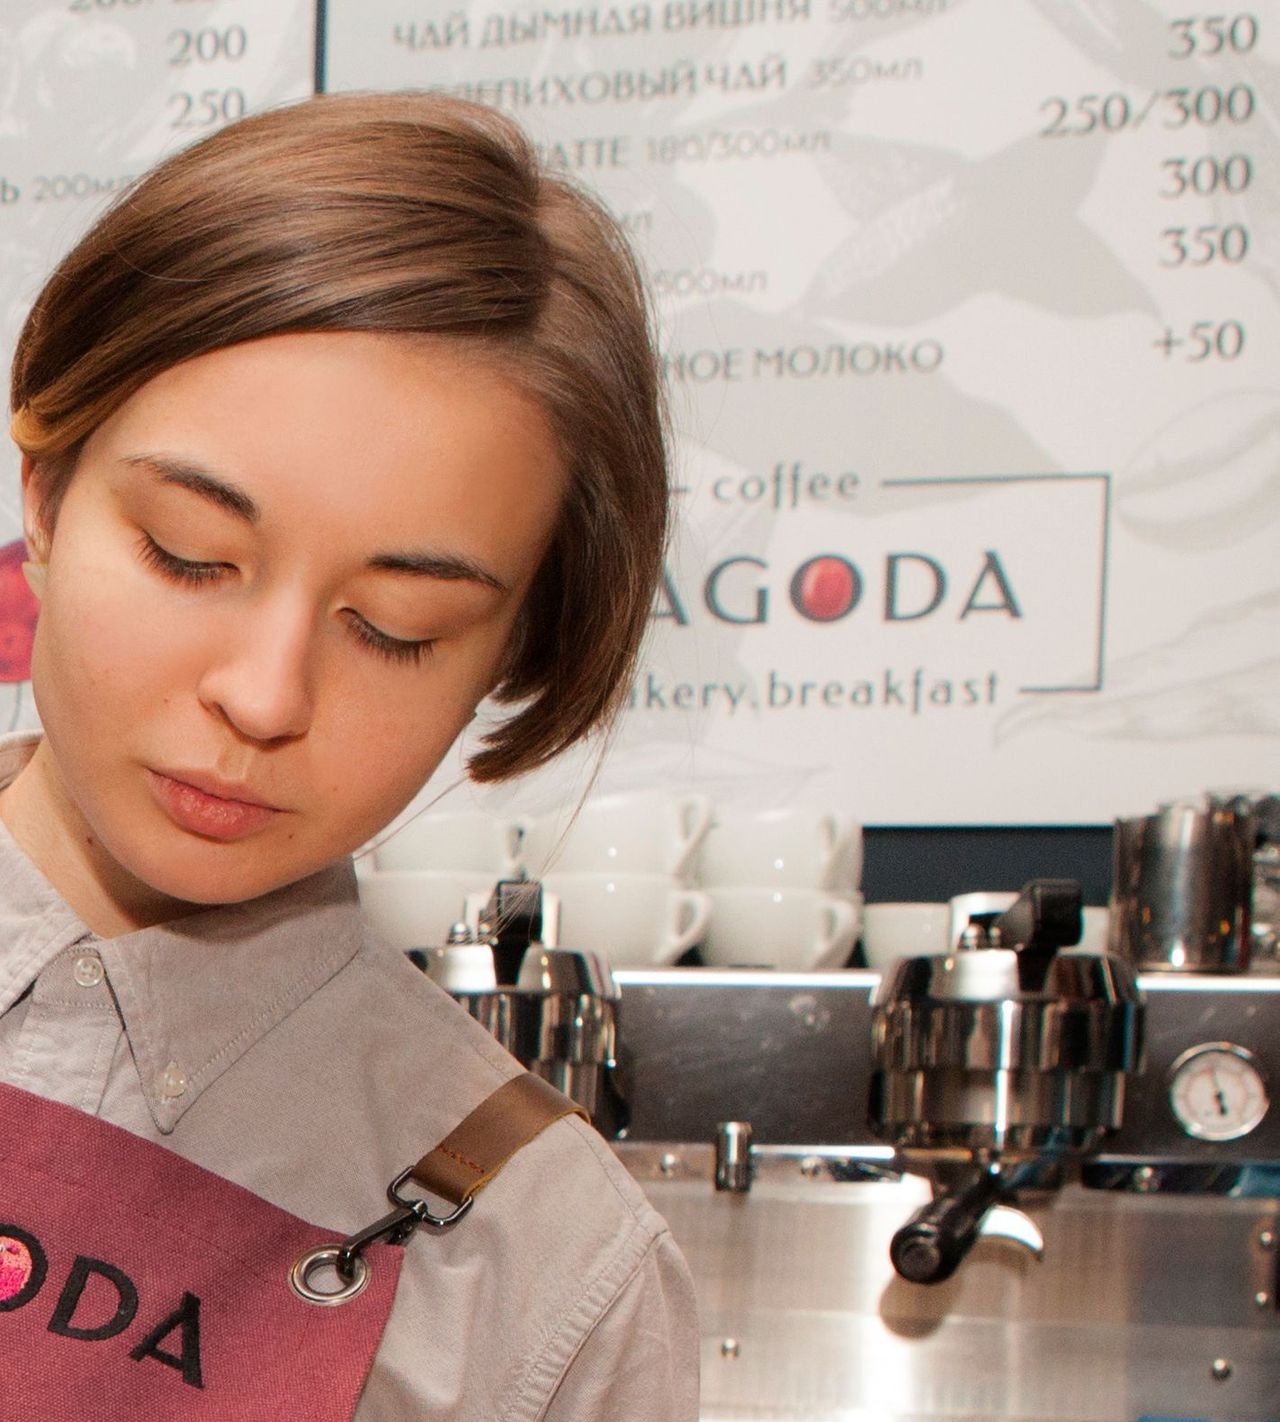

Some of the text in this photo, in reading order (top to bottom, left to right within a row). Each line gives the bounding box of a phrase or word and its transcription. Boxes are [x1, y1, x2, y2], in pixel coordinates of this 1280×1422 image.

[167, 25, 246, 67] 200
[393, 10, 470, 50] ЧАЙ
[481, 3, 652, 49] ДЫМНАЯ
[662, 0, 811, 32] ВИШНЯ
[1168, 13, 1259, 60] 350
[704, 53, 787, 90] ЧАЙ
[809, 55, 924, 88] 350мл
[168, 86, 246, 129] 250
[1039, 83, 1257, 139] 250/300
[1159, 155, 1253, 199] 300
[1159, 223, 1249, 270] 350
[752, 337, 944, 379] МОЛОКО
[1153, 319, 1246, 364] +50
[712, 462, 861, 510] coffee
[652, 550, 1024, 627] AGODA
